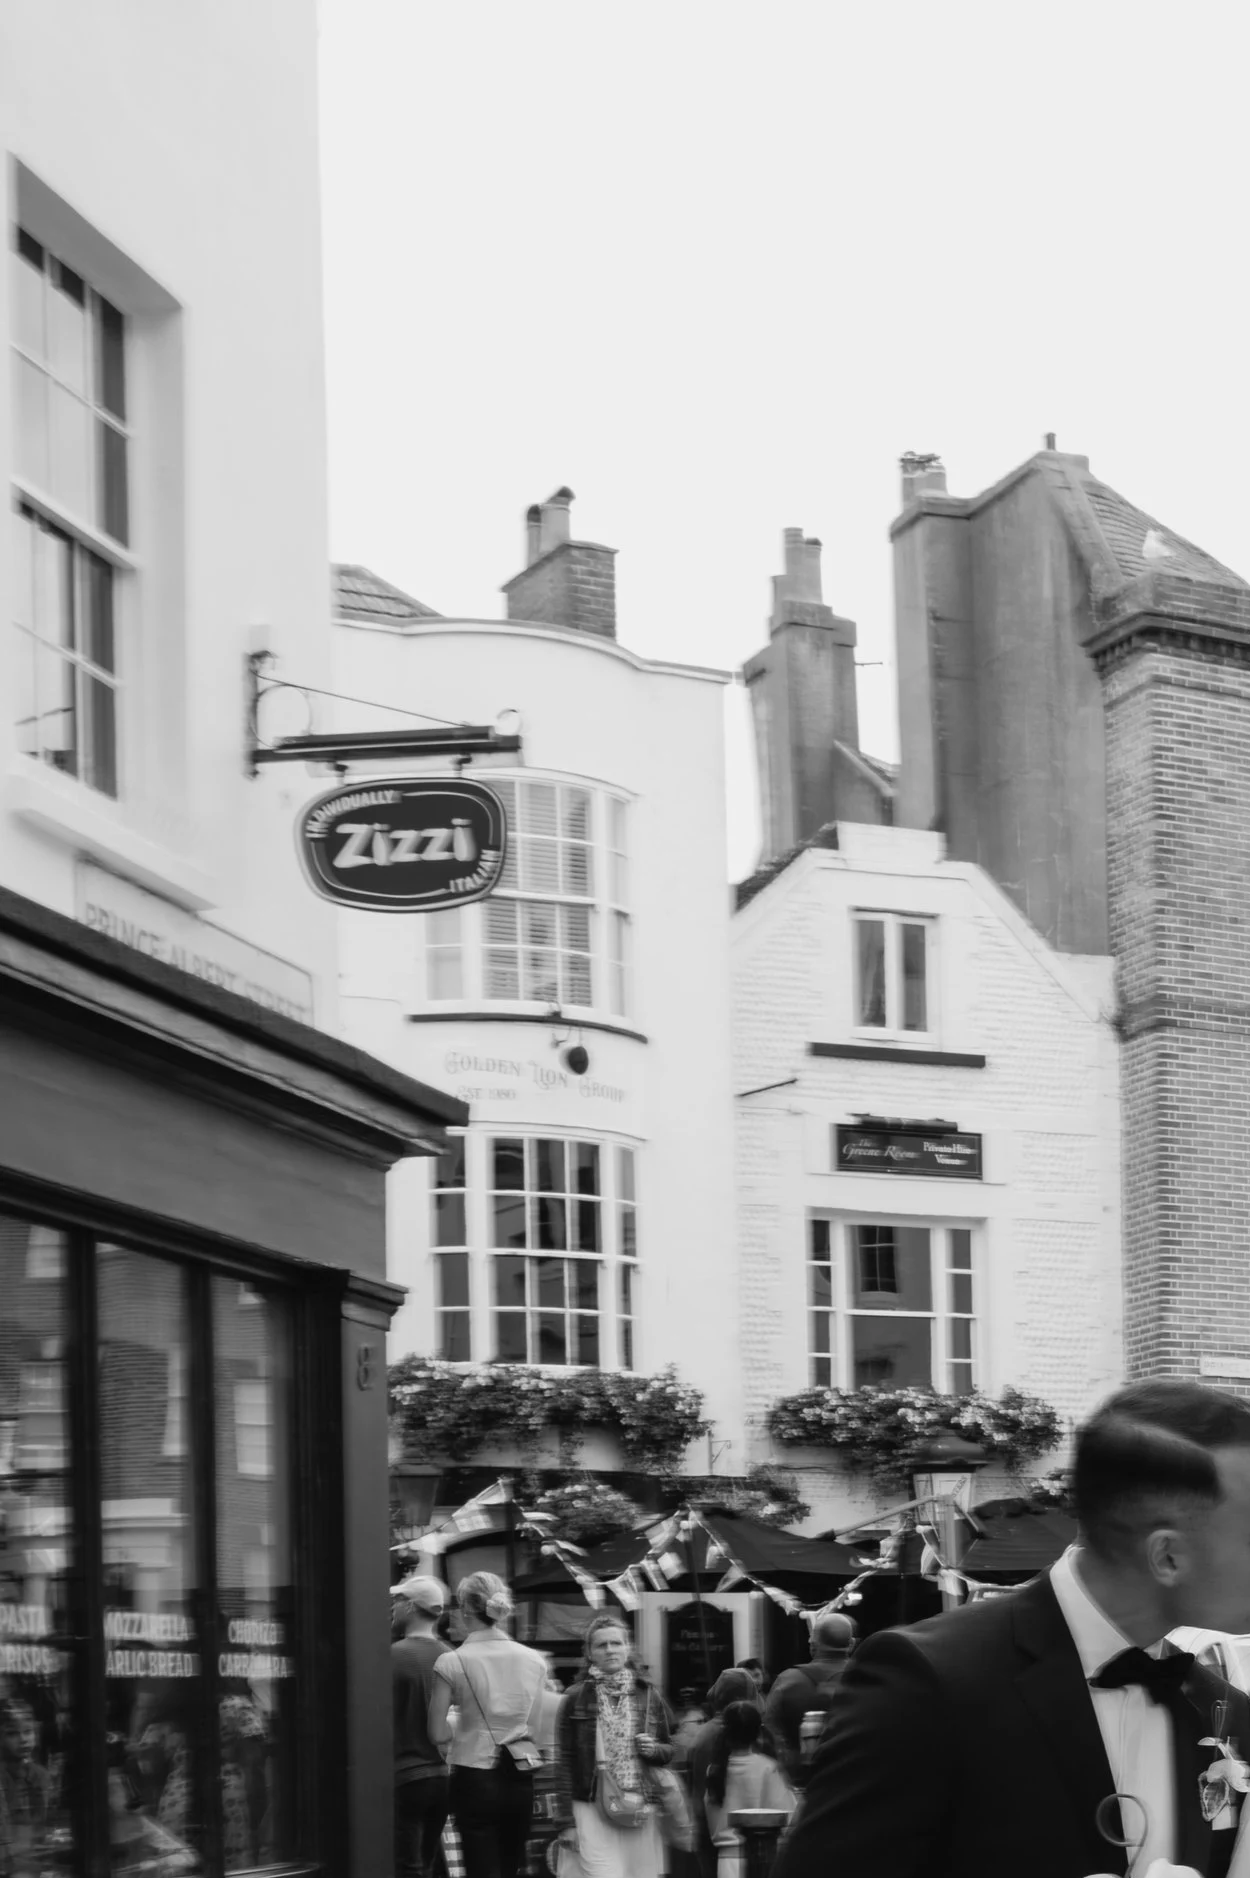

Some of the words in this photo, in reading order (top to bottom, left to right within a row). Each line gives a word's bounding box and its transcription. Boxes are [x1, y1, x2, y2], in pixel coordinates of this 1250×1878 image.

[306, 790, 398, 838] INDIVIDUALLY
[333, 818, 475, 869] Zizzi
[450, 849, 500, 893] ITALIAN
[85, 901, 162, 957] PRINCE
[148, 1651, 196, 1677] BREAD
